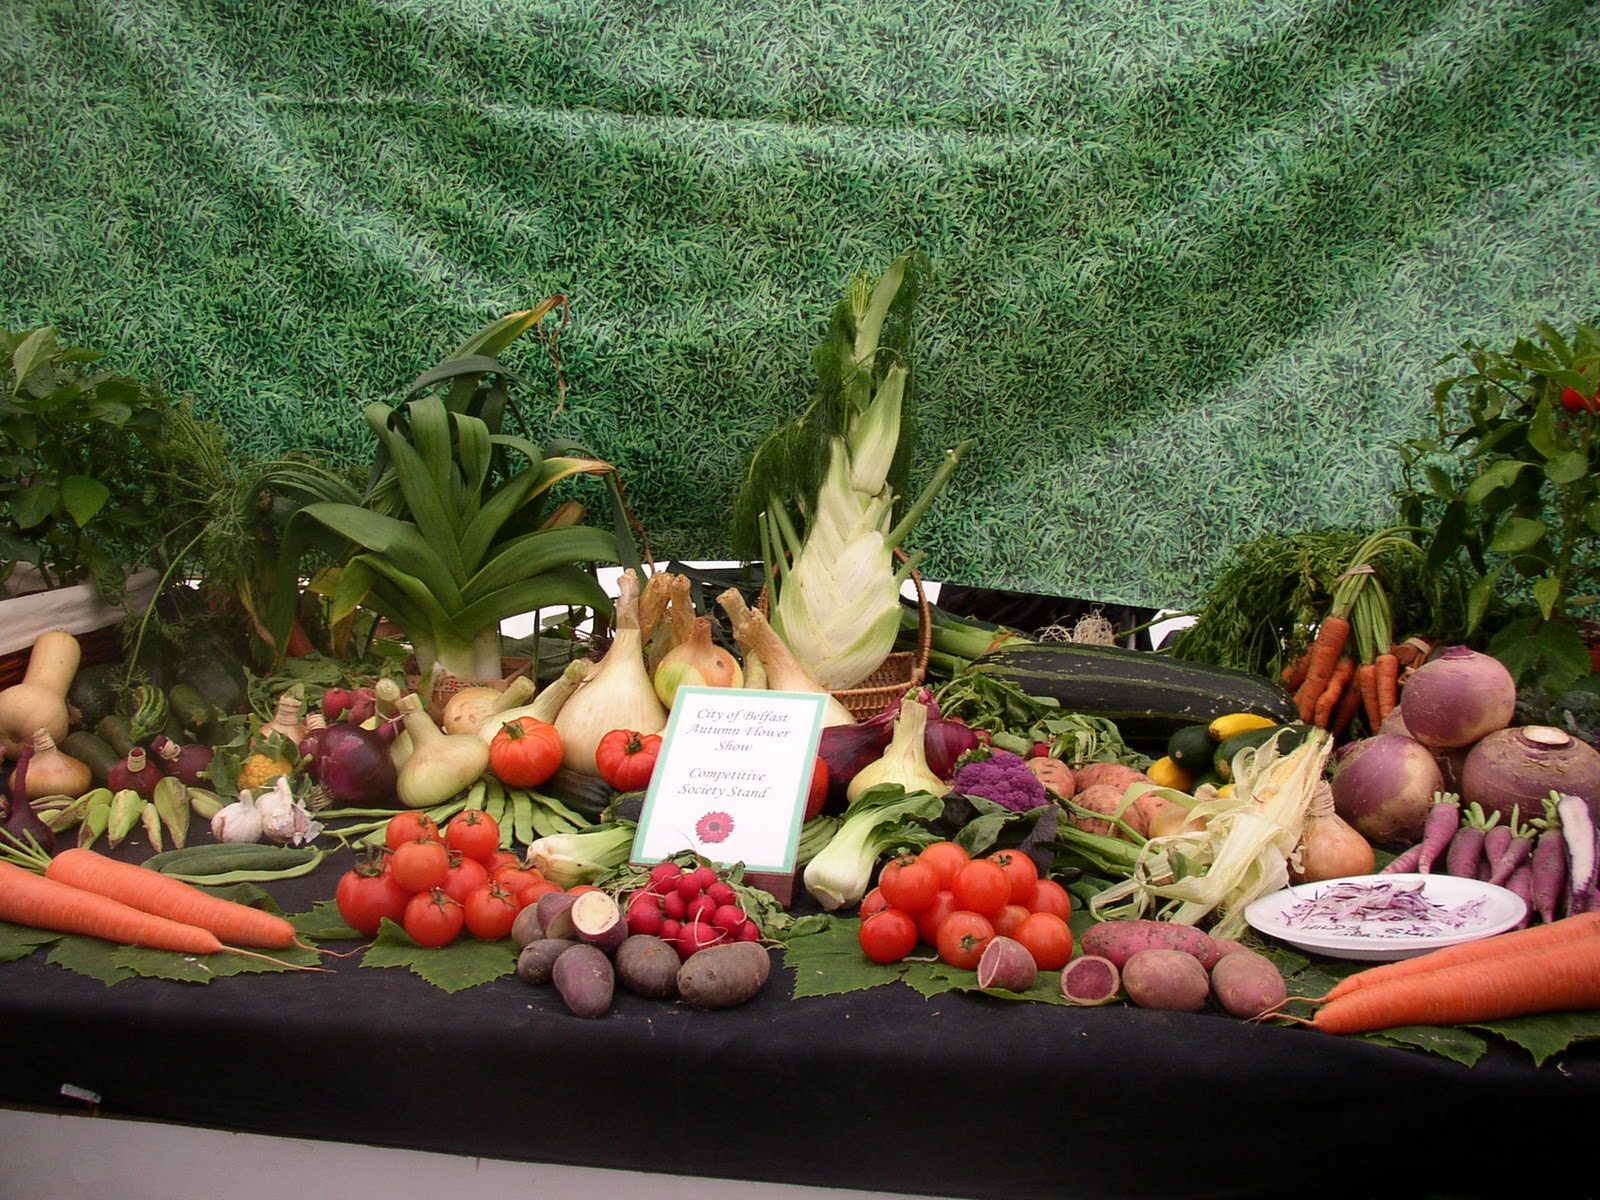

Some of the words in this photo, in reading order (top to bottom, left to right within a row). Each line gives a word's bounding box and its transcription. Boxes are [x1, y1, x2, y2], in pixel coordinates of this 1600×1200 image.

[697, 708, 724, 722] City
[726, 709, 743, 723] of
[744, 710, 788, 724] Belfast
[686, 723, 740, 736] Autumn
[744, 726, 791, 738] Flower
[715, 740, 753, 752] Show
[689, 767, 767, 782] Competitive
[678, 784, 726, 799] Society
[727, 786, 771, 799] Stand
